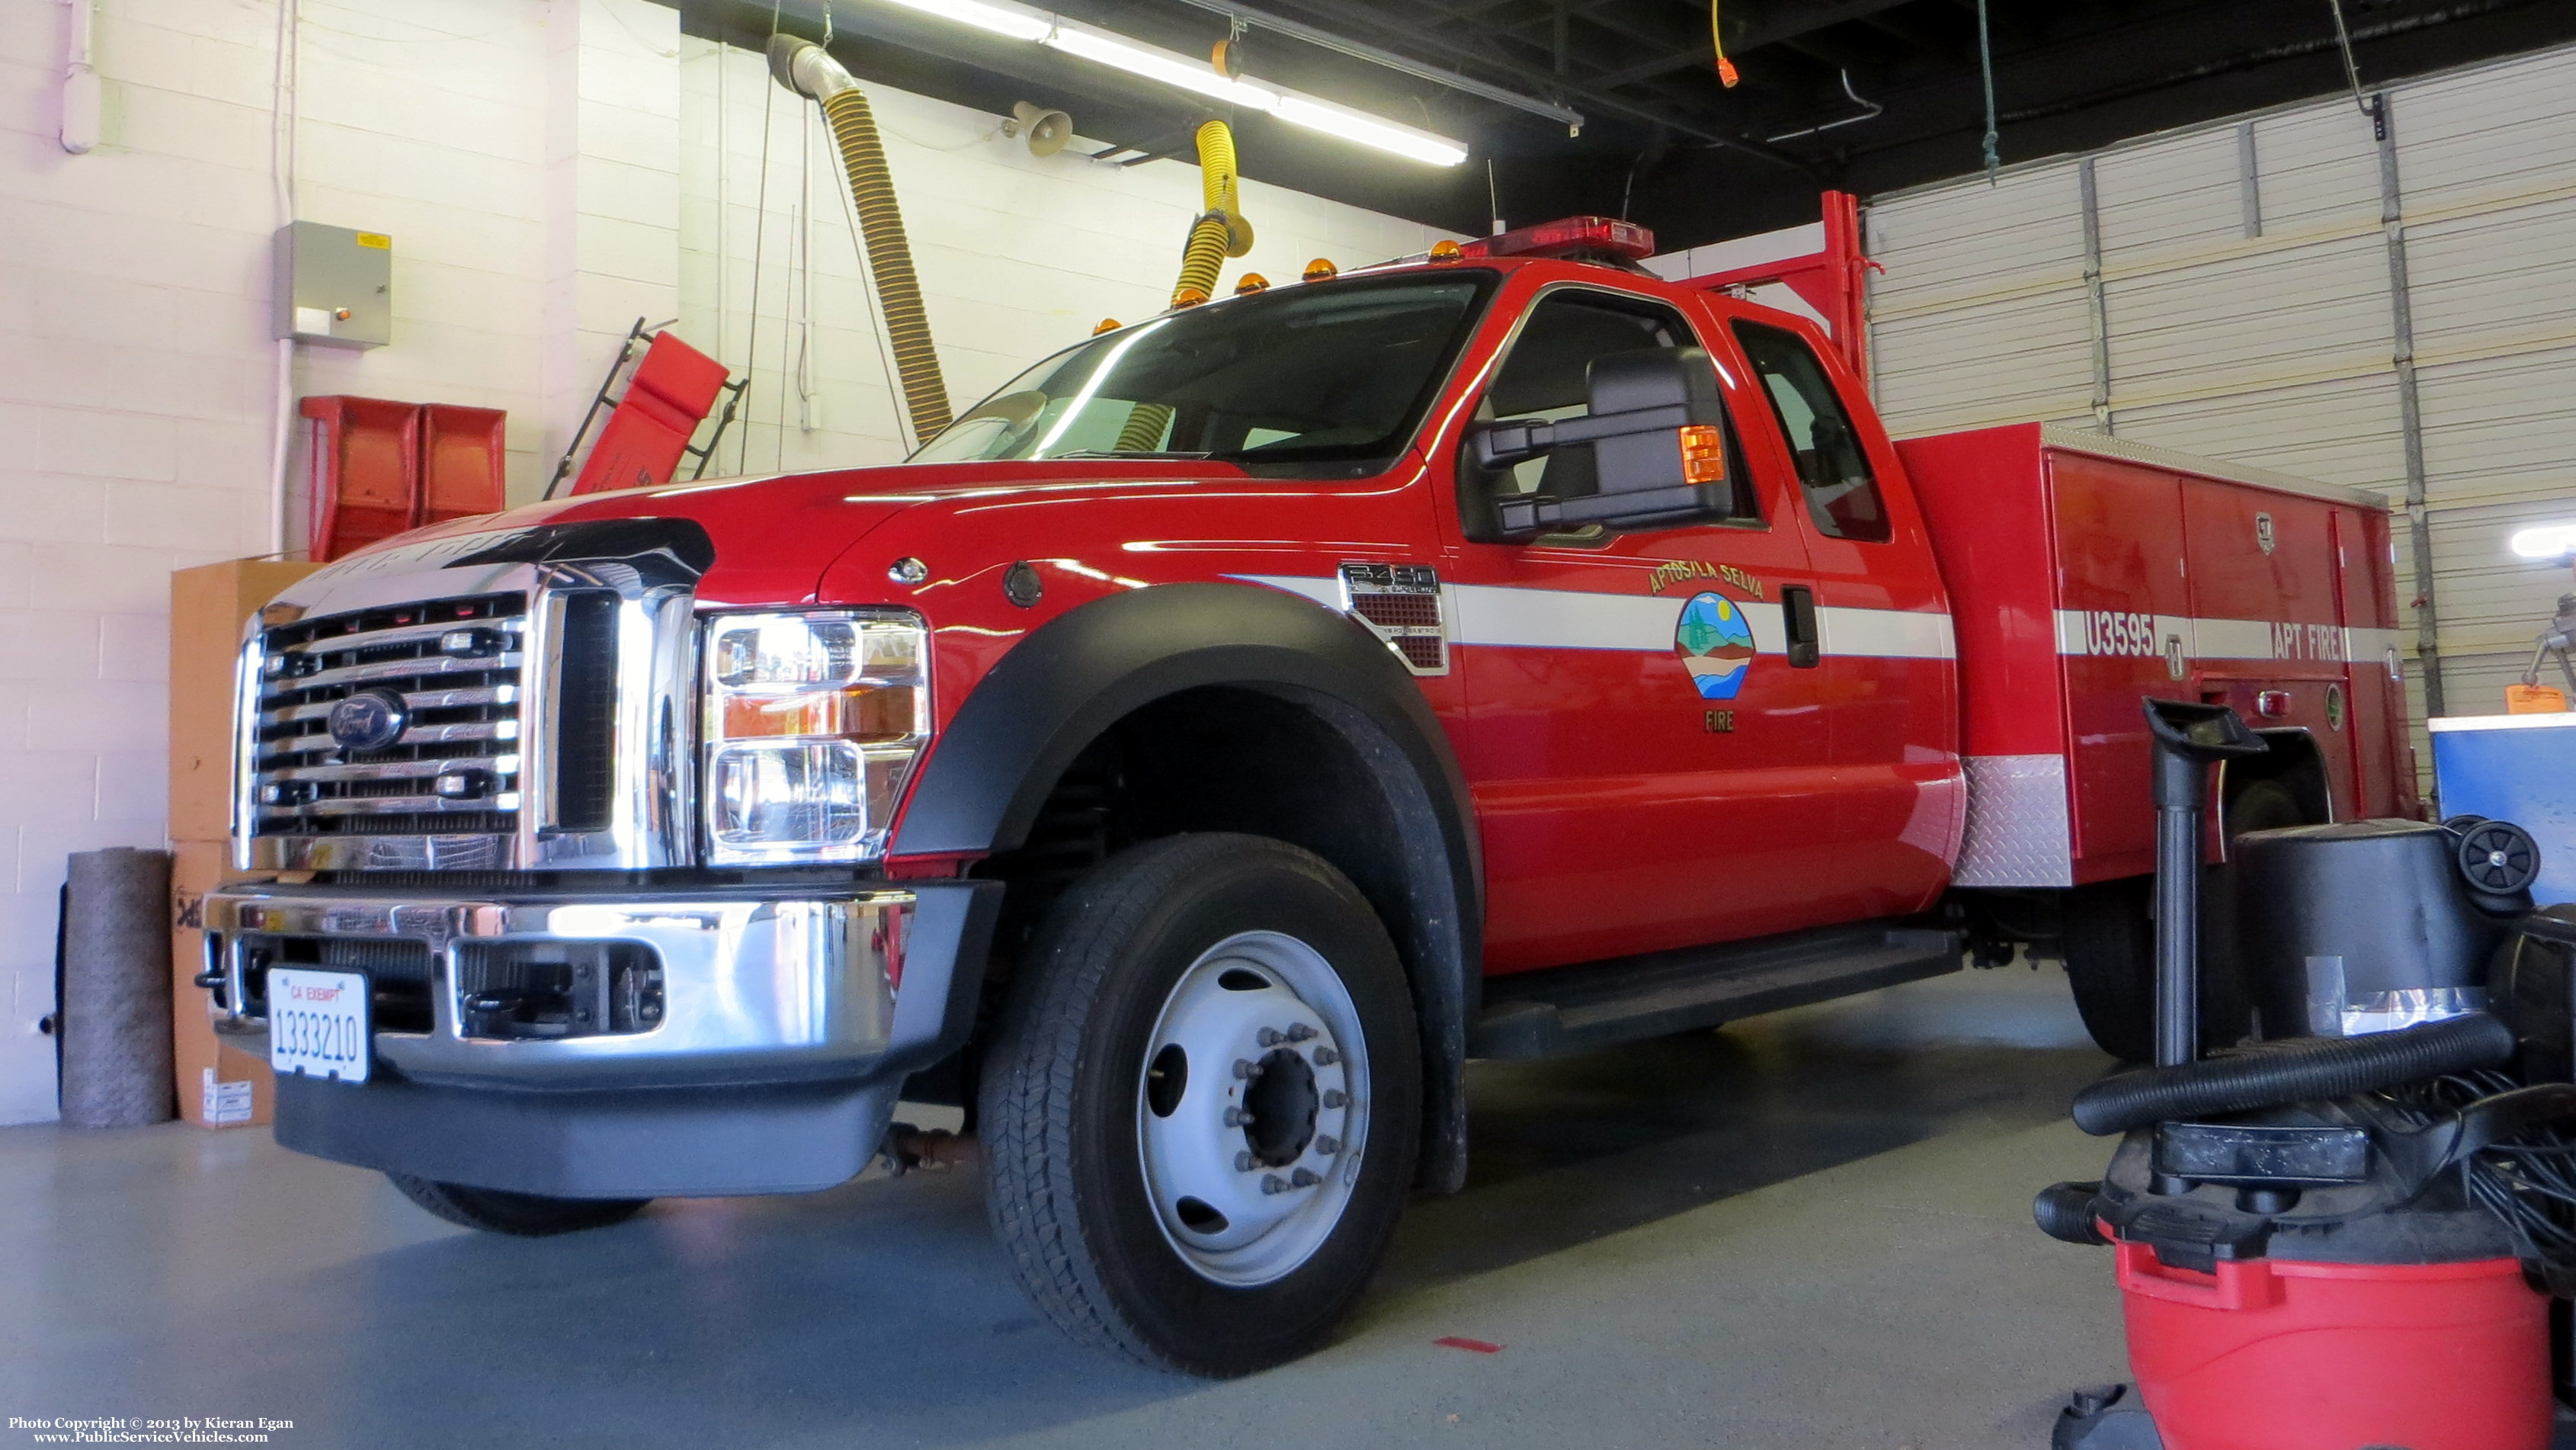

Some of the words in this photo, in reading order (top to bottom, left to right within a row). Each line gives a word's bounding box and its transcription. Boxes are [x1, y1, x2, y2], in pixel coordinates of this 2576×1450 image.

[1649, 560, 1719, 594] APTOS/LA
[1719, 564, 1764, 601] SELVA
[2085, 611, 2154, 656] U3595
[2274, 621, 2302, 660] APT
[2307, 624, 2341, 661] FIRE
[338, 701, 376, 735] Ford
[1705, 710, 1735, 732] FIRE
[290, 985, 303, 999] CA
[306, 986, 341, 1002] EXEMPT
[276, 1008, 357, 1063] 1333210
